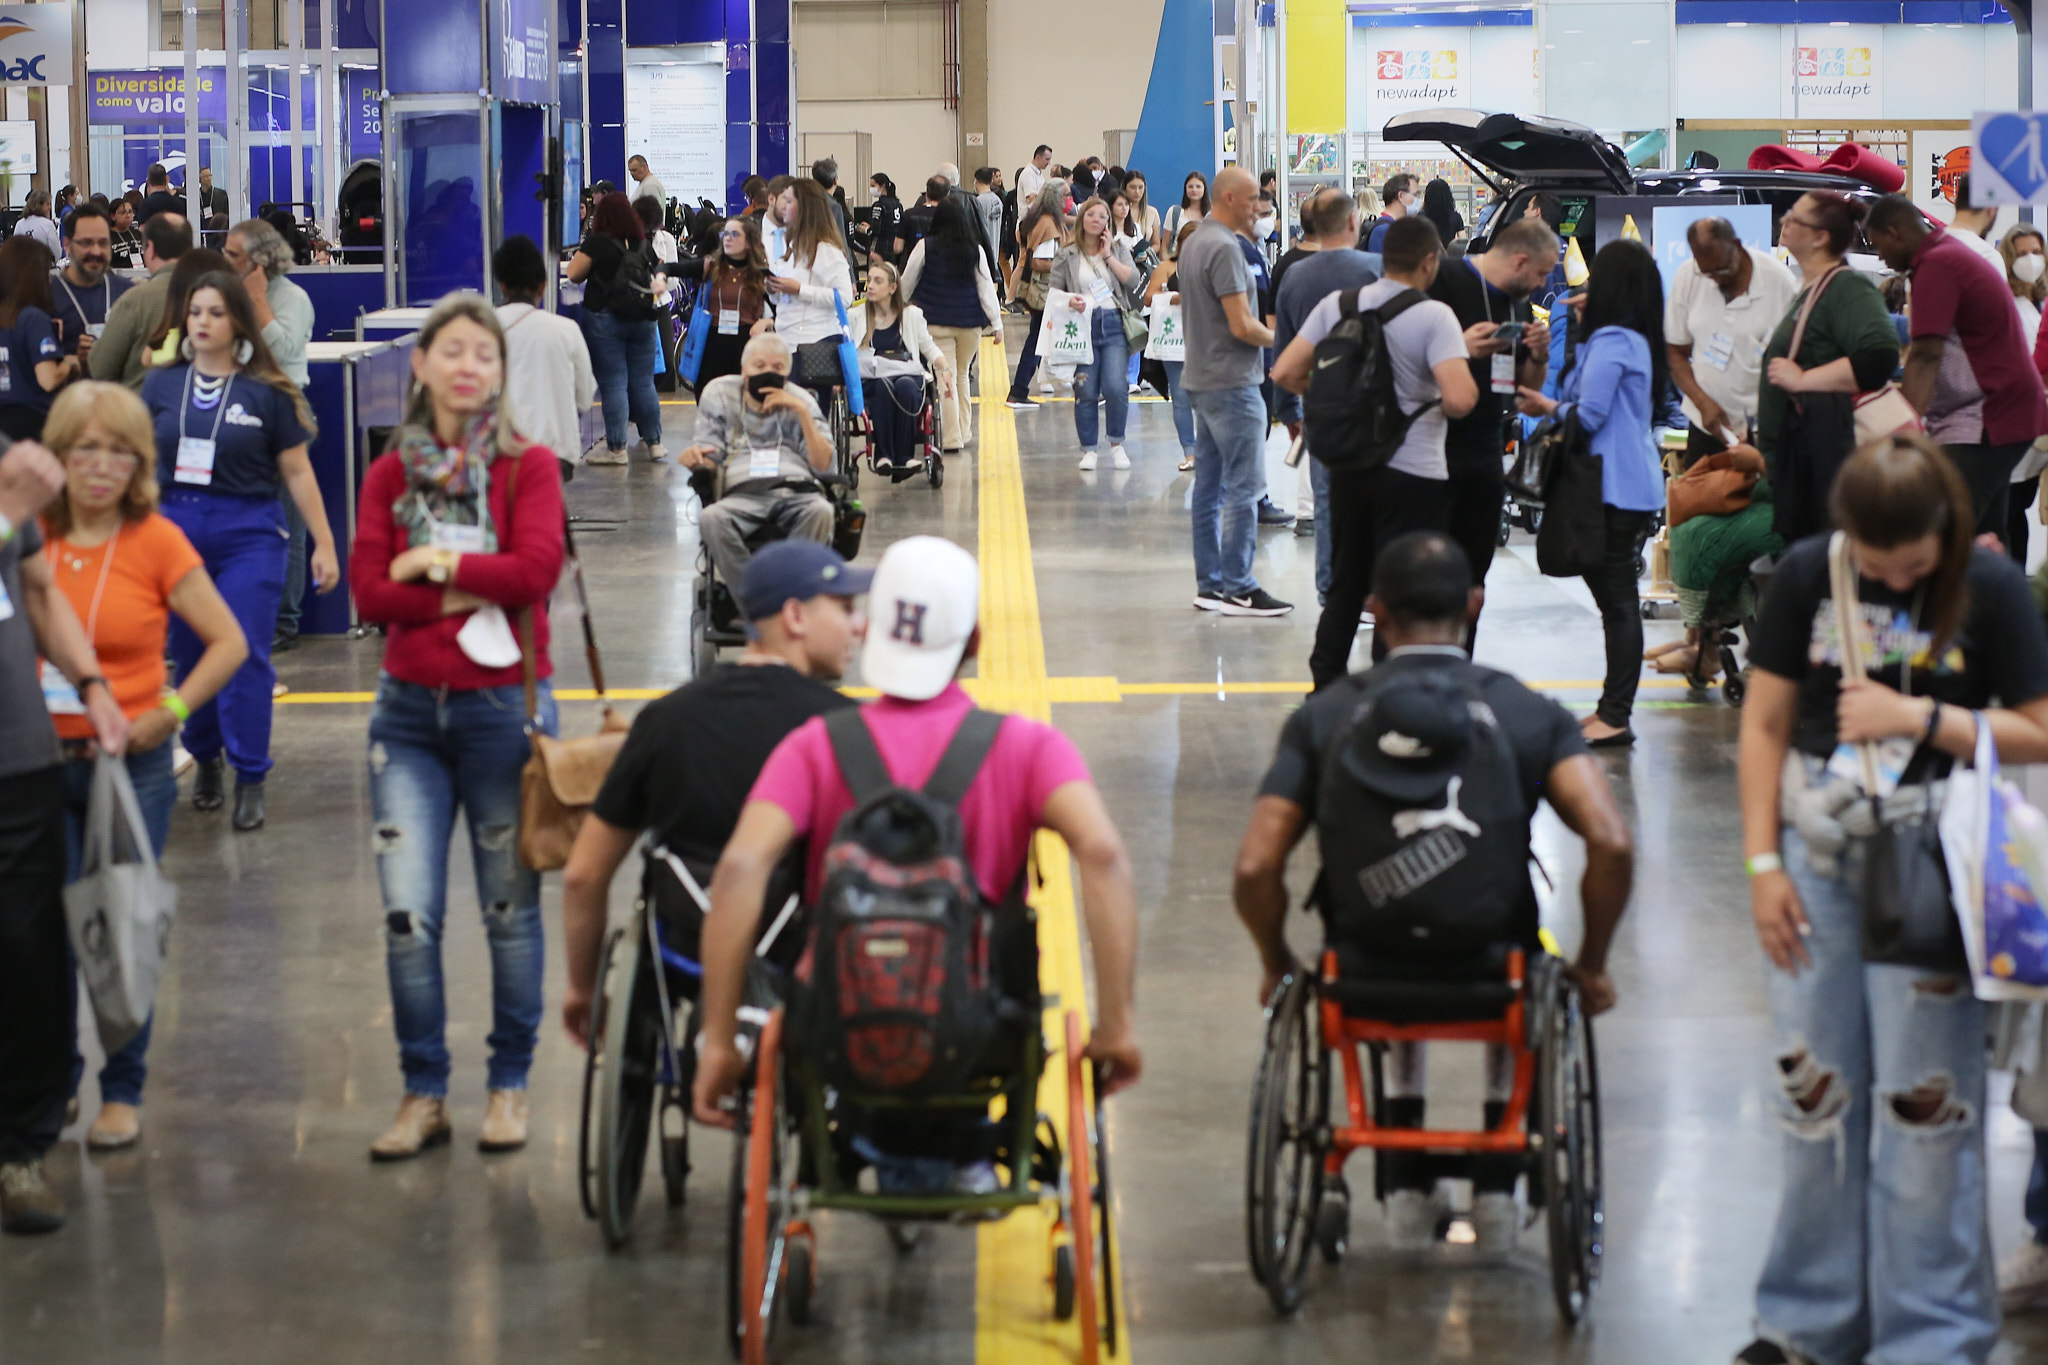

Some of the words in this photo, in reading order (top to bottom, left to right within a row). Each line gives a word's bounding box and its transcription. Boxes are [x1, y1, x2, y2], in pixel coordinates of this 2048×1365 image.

[1377, 83, 1458, 102] newadapt
[96, 97, 133, 107] como
[135, 93, 200, 113] valo
[1055, 336, 1087, 350] abem
[889, 599, 927, 647] H
